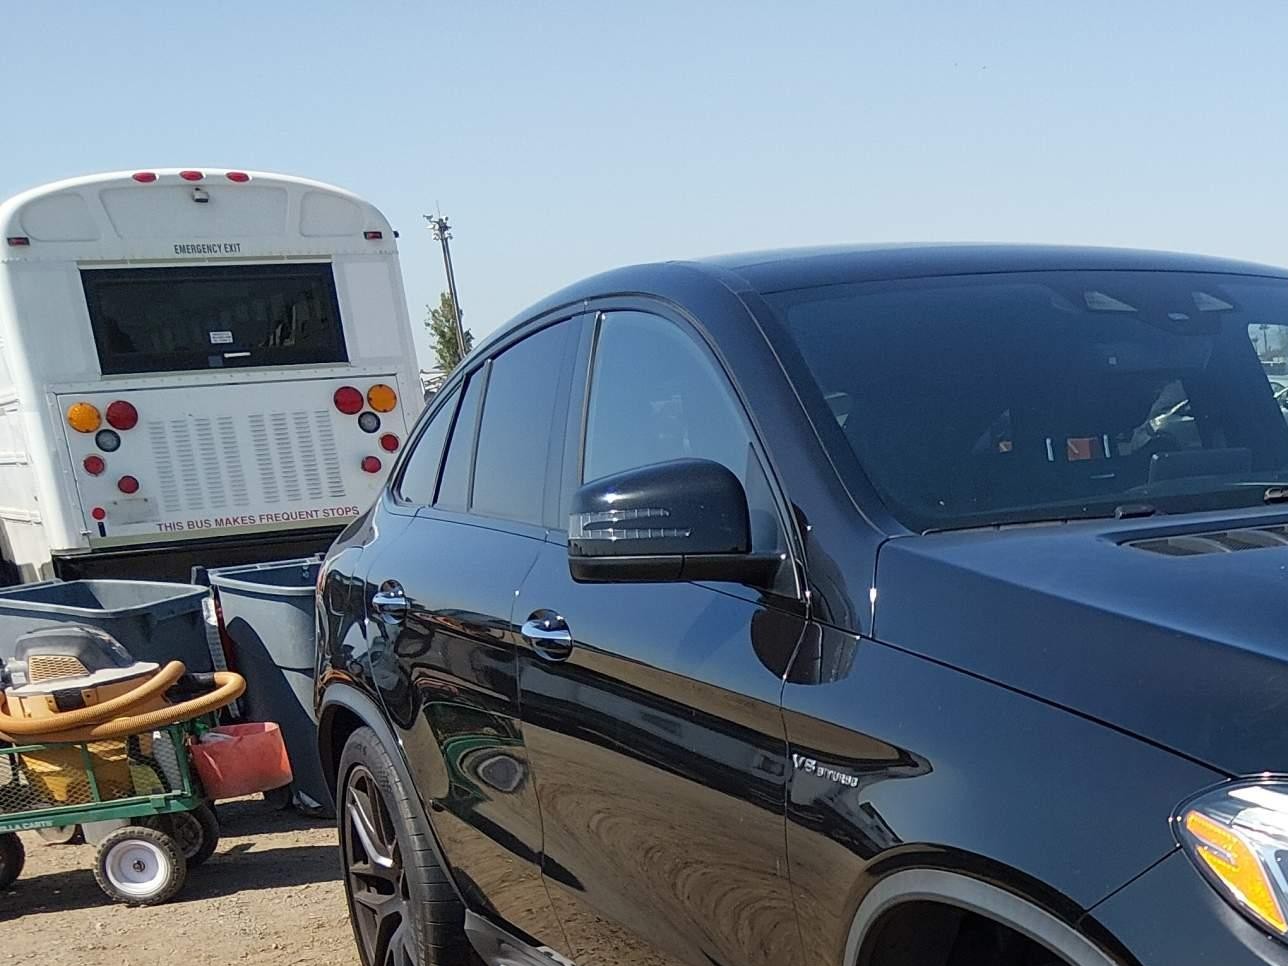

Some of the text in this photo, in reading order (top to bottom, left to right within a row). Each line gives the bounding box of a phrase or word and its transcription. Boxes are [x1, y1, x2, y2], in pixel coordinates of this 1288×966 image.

[174, 243, 241, 255] EMERGENCY EXIT
[157, 505, 360, 532] THIS BUS MAKES FREQUENT STOPS
